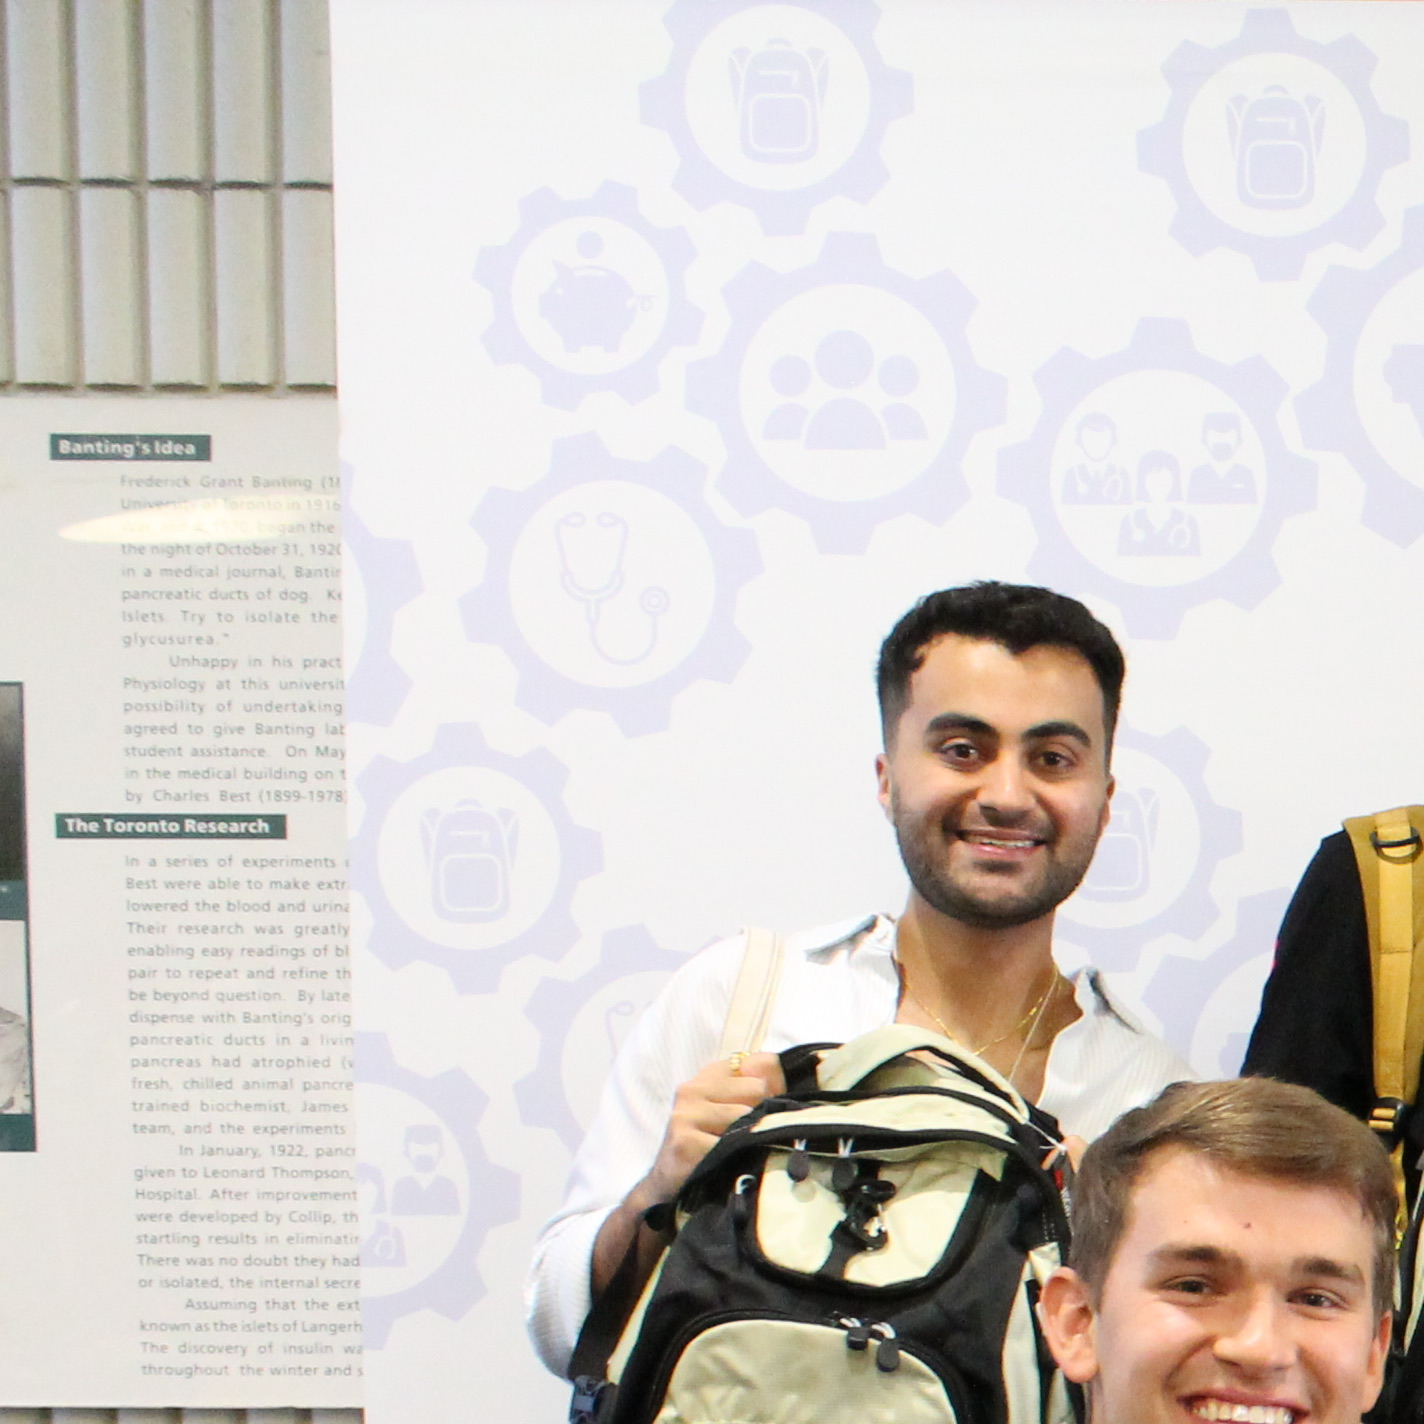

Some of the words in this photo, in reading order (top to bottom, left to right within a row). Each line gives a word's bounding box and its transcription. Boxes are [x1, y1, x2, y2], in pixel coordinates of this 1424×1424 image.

[59, 440, 151, 457] Banting's
[155, 440, 196, 455] Idea
[65, 818, 100, 834] The
[104, 818, 180, 834] Toronto
[184, 818, 270, 834] Research
